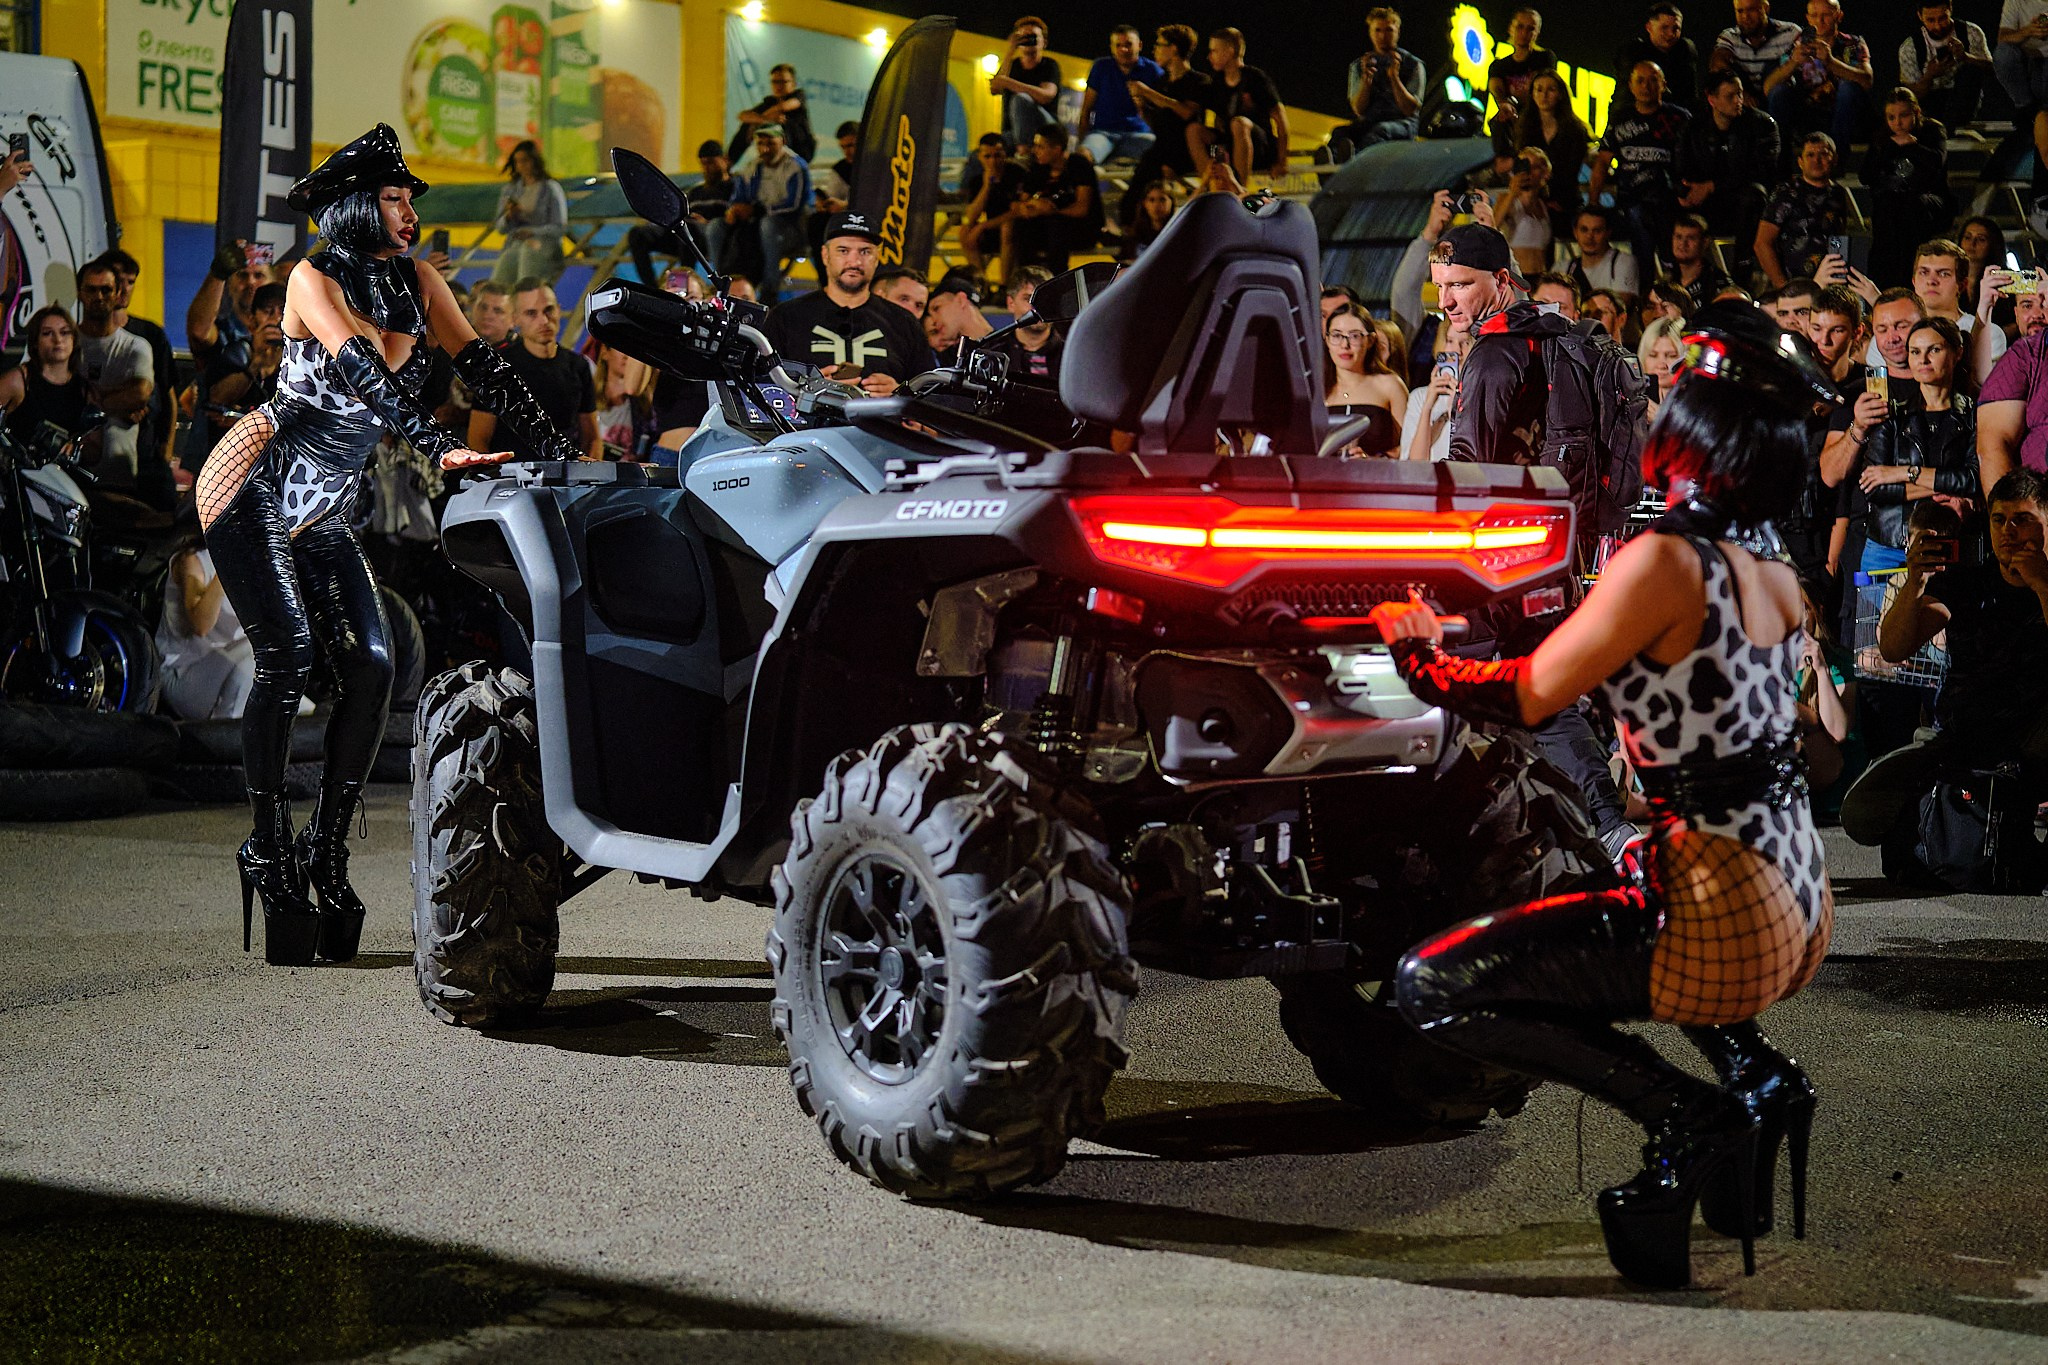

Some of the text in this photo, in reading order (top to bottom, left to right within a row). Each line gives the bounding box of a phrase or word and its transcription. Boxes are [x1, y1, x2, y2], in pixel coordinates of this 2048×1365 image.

[138, 60, 223, 115] FRE
[878, 114, 916, 265] Moto
[712, 476, 750, 491] 1000
[896, 499, 1008, 520] CFMOTO
